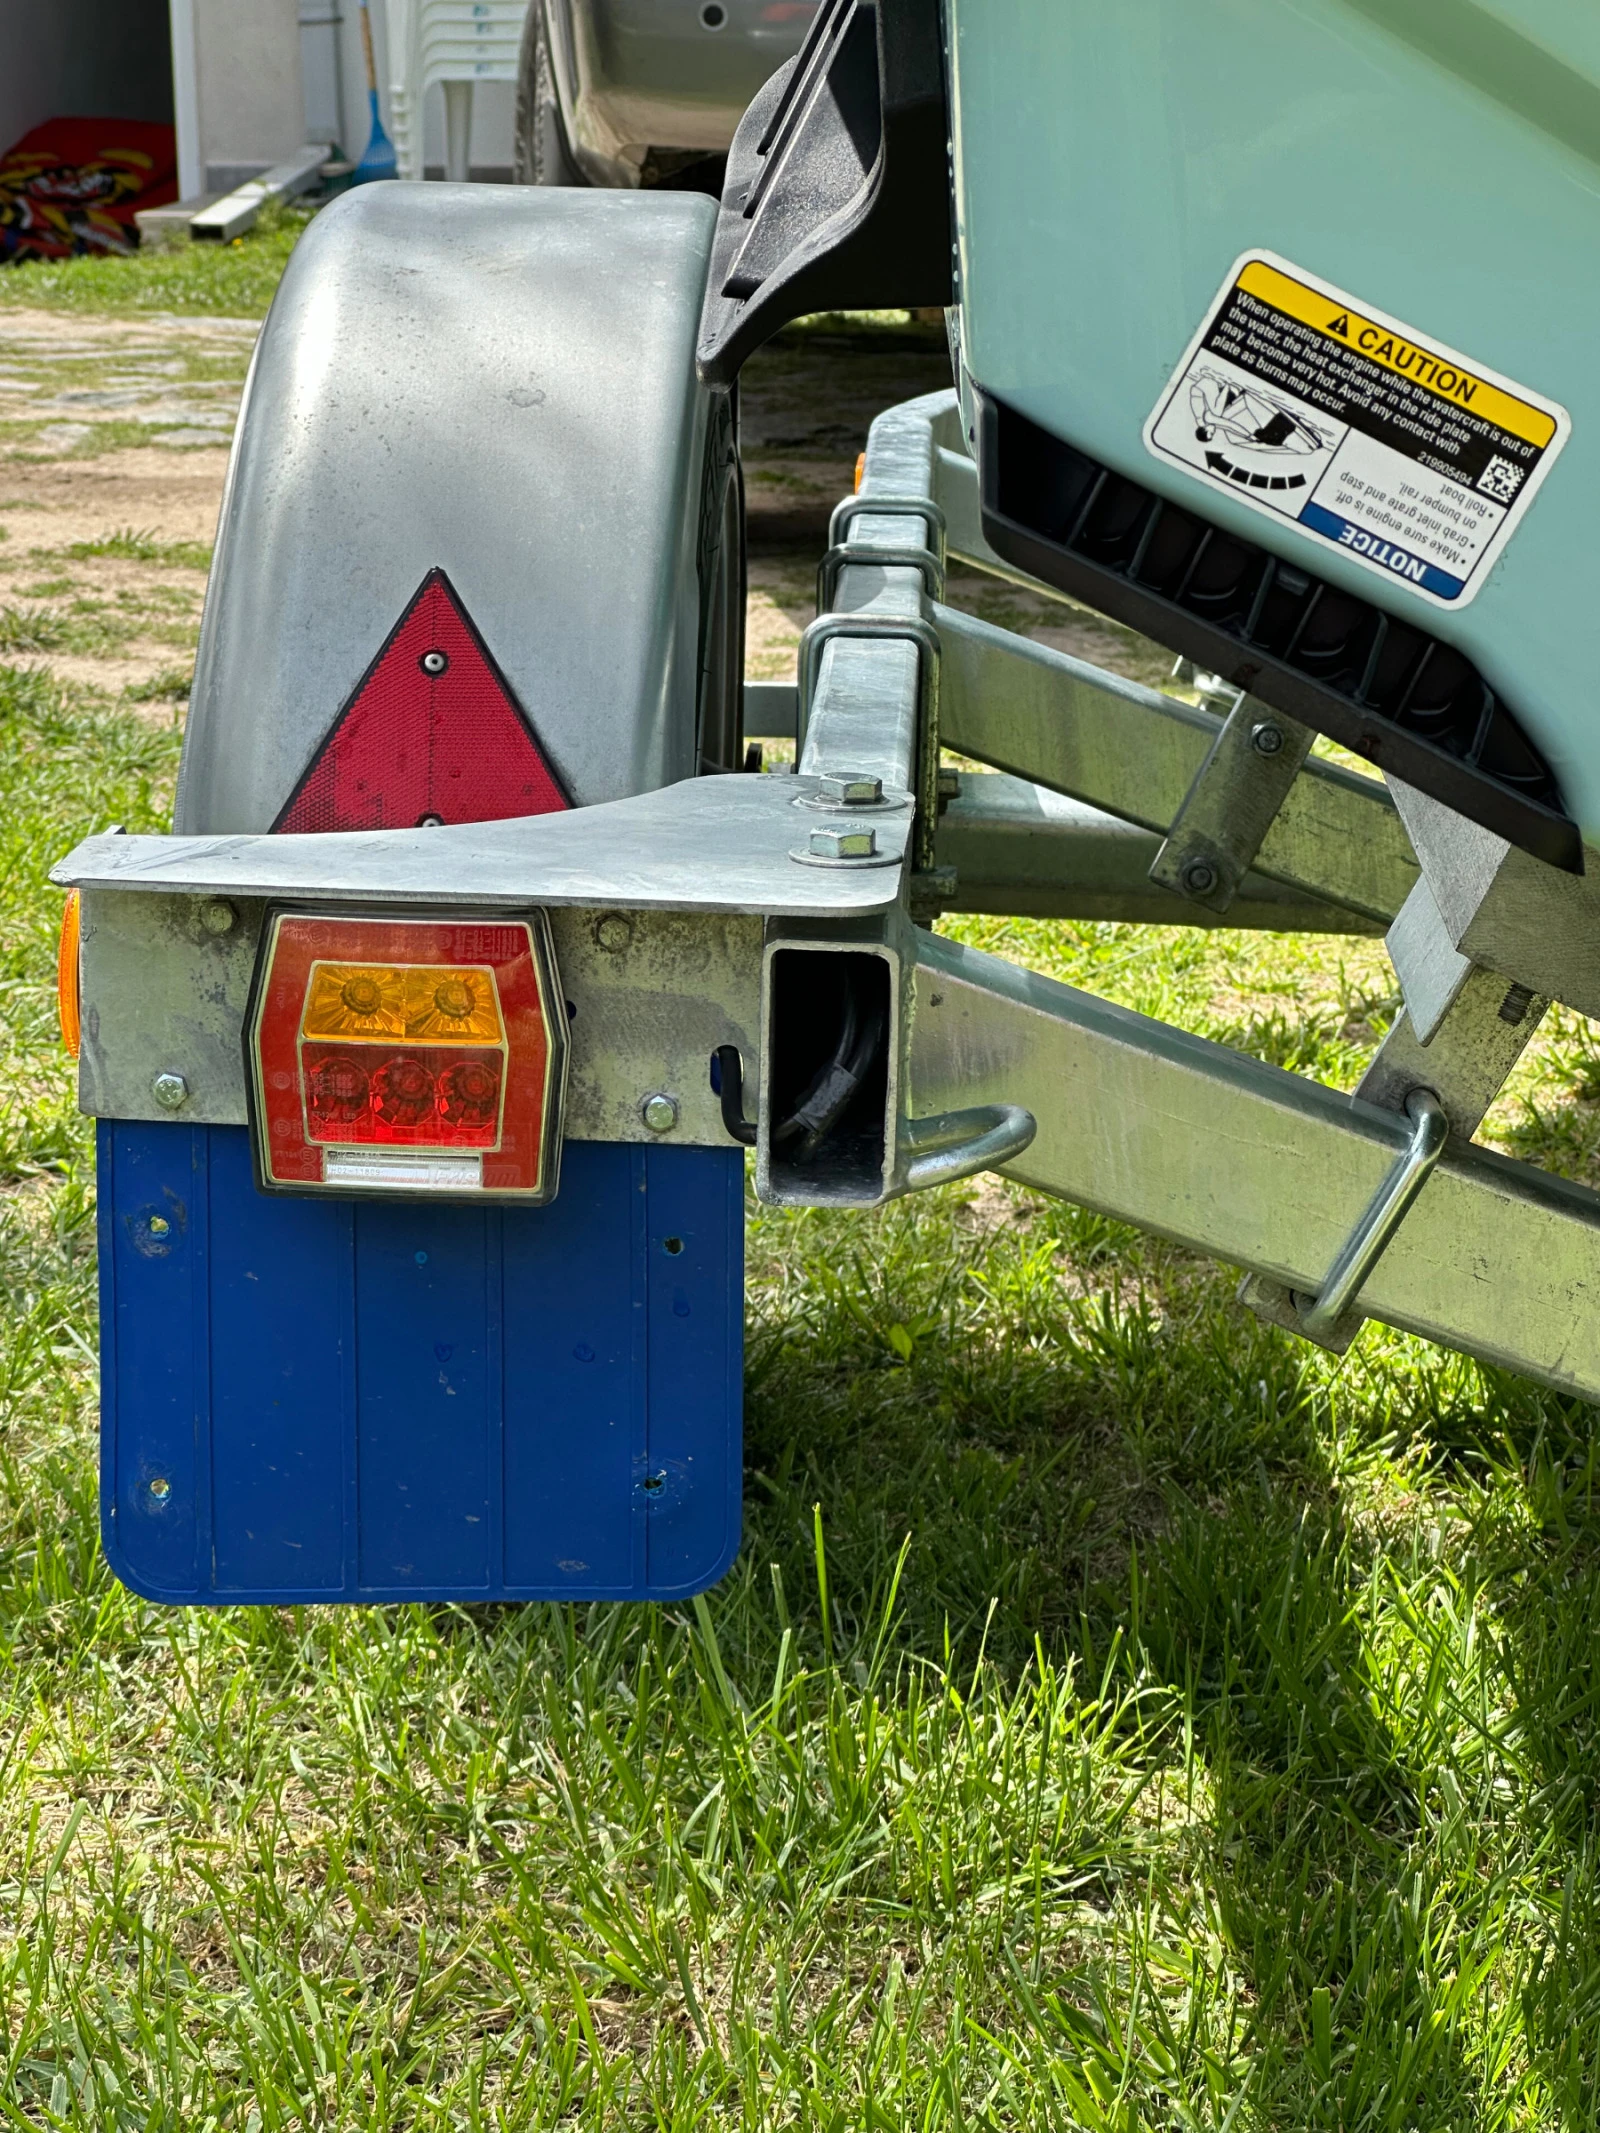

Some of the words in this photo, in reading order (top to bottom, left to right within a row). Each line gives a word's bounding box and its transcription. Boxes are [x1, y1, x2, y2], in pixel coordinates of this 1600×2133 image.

[1210, 335, 1240, 355] plate
[1240, 350, 1255, 364] as
[1255, 355, 1288, 381] burns
[1287, 375, 1312, 395] may
[1311, 388, 1345, 412] occur.
[1228, 307, 1247, 324] the
[1247, 318, 1281, 344] water,
[1282, 336, 1301, 353] the
[1301, 345, 1328, 367] heat
[1328, 362, 1387, 397] exchanger
[1386, 390, 1399, 404] in
[1399, 398, 1418, 415] the
[1418, 409, 1441, 427] ride
[1440, 422, 1470, 442] plate
[1236, 291, 1269, 318] When
[1269, 313, 1322, 348] operating
[1322, 339, 1341, 357] the
[1342, 352, 1380, 377] engine
[1381, 372, 1411, 393] while
[1411, 387, 1430, 404] the
[1431, 399, 1489, 435] watercraft
[1489, 426, 1500, 441] is
[1500, 436, 1520, 451] out
[1520, 446, 1535, 457] of
[1358, 328, 1477, 402] CAUTION
[1220, 321, 1245, 341] may
[1246, 332, 1290, 364] become
[1292, 358, 1317, 379] very
[1315, 370, 1336, 390] hot.
[1337, 383, 1371, 407] Avoid
[1370, 402, 1392, 420] any
[1392, 414, 1435, 441] contact
[1435, 435, 1460, 454] with
[1417, 451, 1472, 485] 219905494
[1340, 471, 1364, 490] step
[1398, 482, 1419, 498] rail.
[1335, 491, 1352, 504] off.
[1363, 485, 1386, 501] and
[1439, 483, 1465, 505] boat
[1353, 500, 1364, 513] is
[1387, 497, 1417, 517] grate
[1419, 495, 1461, 523] bumper
[1464, 498, 1487, 517] Roll
[1365, 506, 1402, 530] engine
[1416, 512, 1441, 534] inlet
[1462, 516, 1476, 529] on
[1403, 526, 1428, 543] sure
[1442, 526, 1468, 547] Grab
[1338, 524, 1426, 581] NOTICE
[1429, 540, 1460, 563] Make
